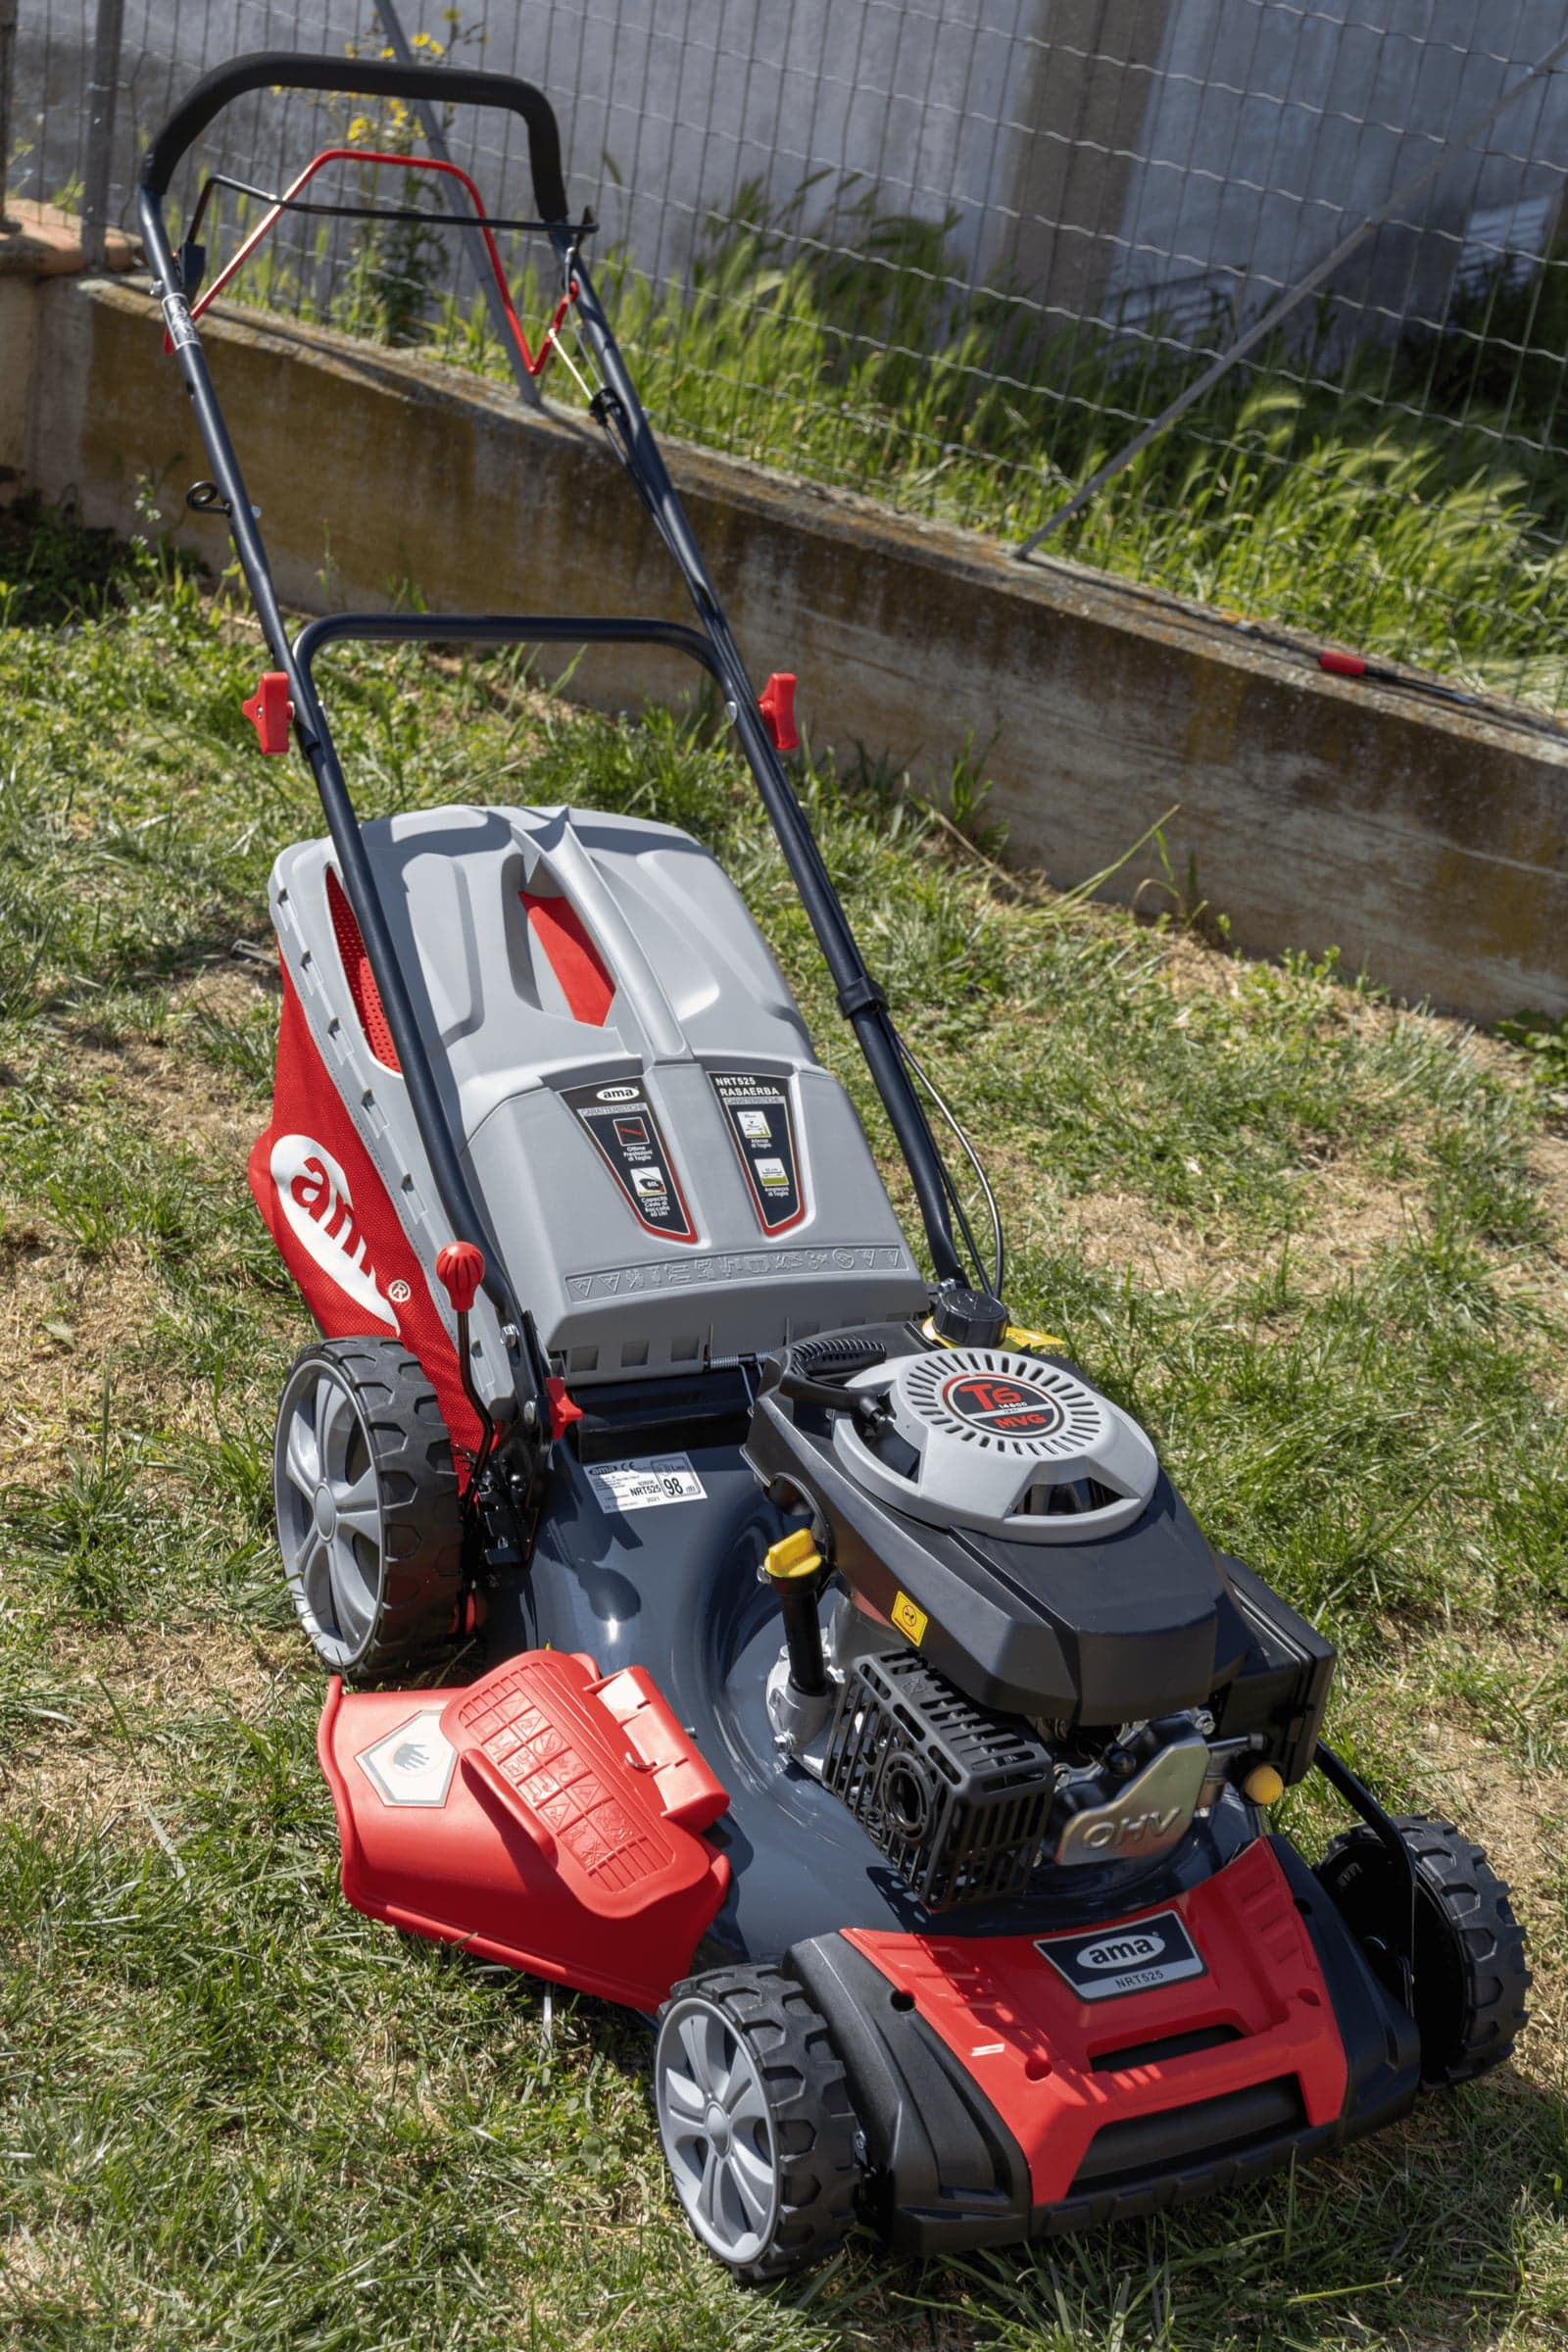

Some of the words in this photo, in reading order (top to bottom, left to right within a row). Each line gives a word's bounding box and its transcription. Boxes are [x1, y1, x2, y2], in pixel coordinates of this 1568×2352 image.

[714, 1076, 756, 1086] NRT525
[603, 1089, 634, 1099] ama
[719, 1087, 780, 1097] RASAERBA
[958, 1383, 1021, 1410] T6
[994, 1413, 1047, 1429] MVG
[629, 1484, 662, 1496] NRT525
[663, 1477, 683, 1495] 98
[1083, 1806, 1180, 1849] OHV
[1089, 1938, 1154, 1965] ama
[1115, 1969, 1164, 1988] NRT525
